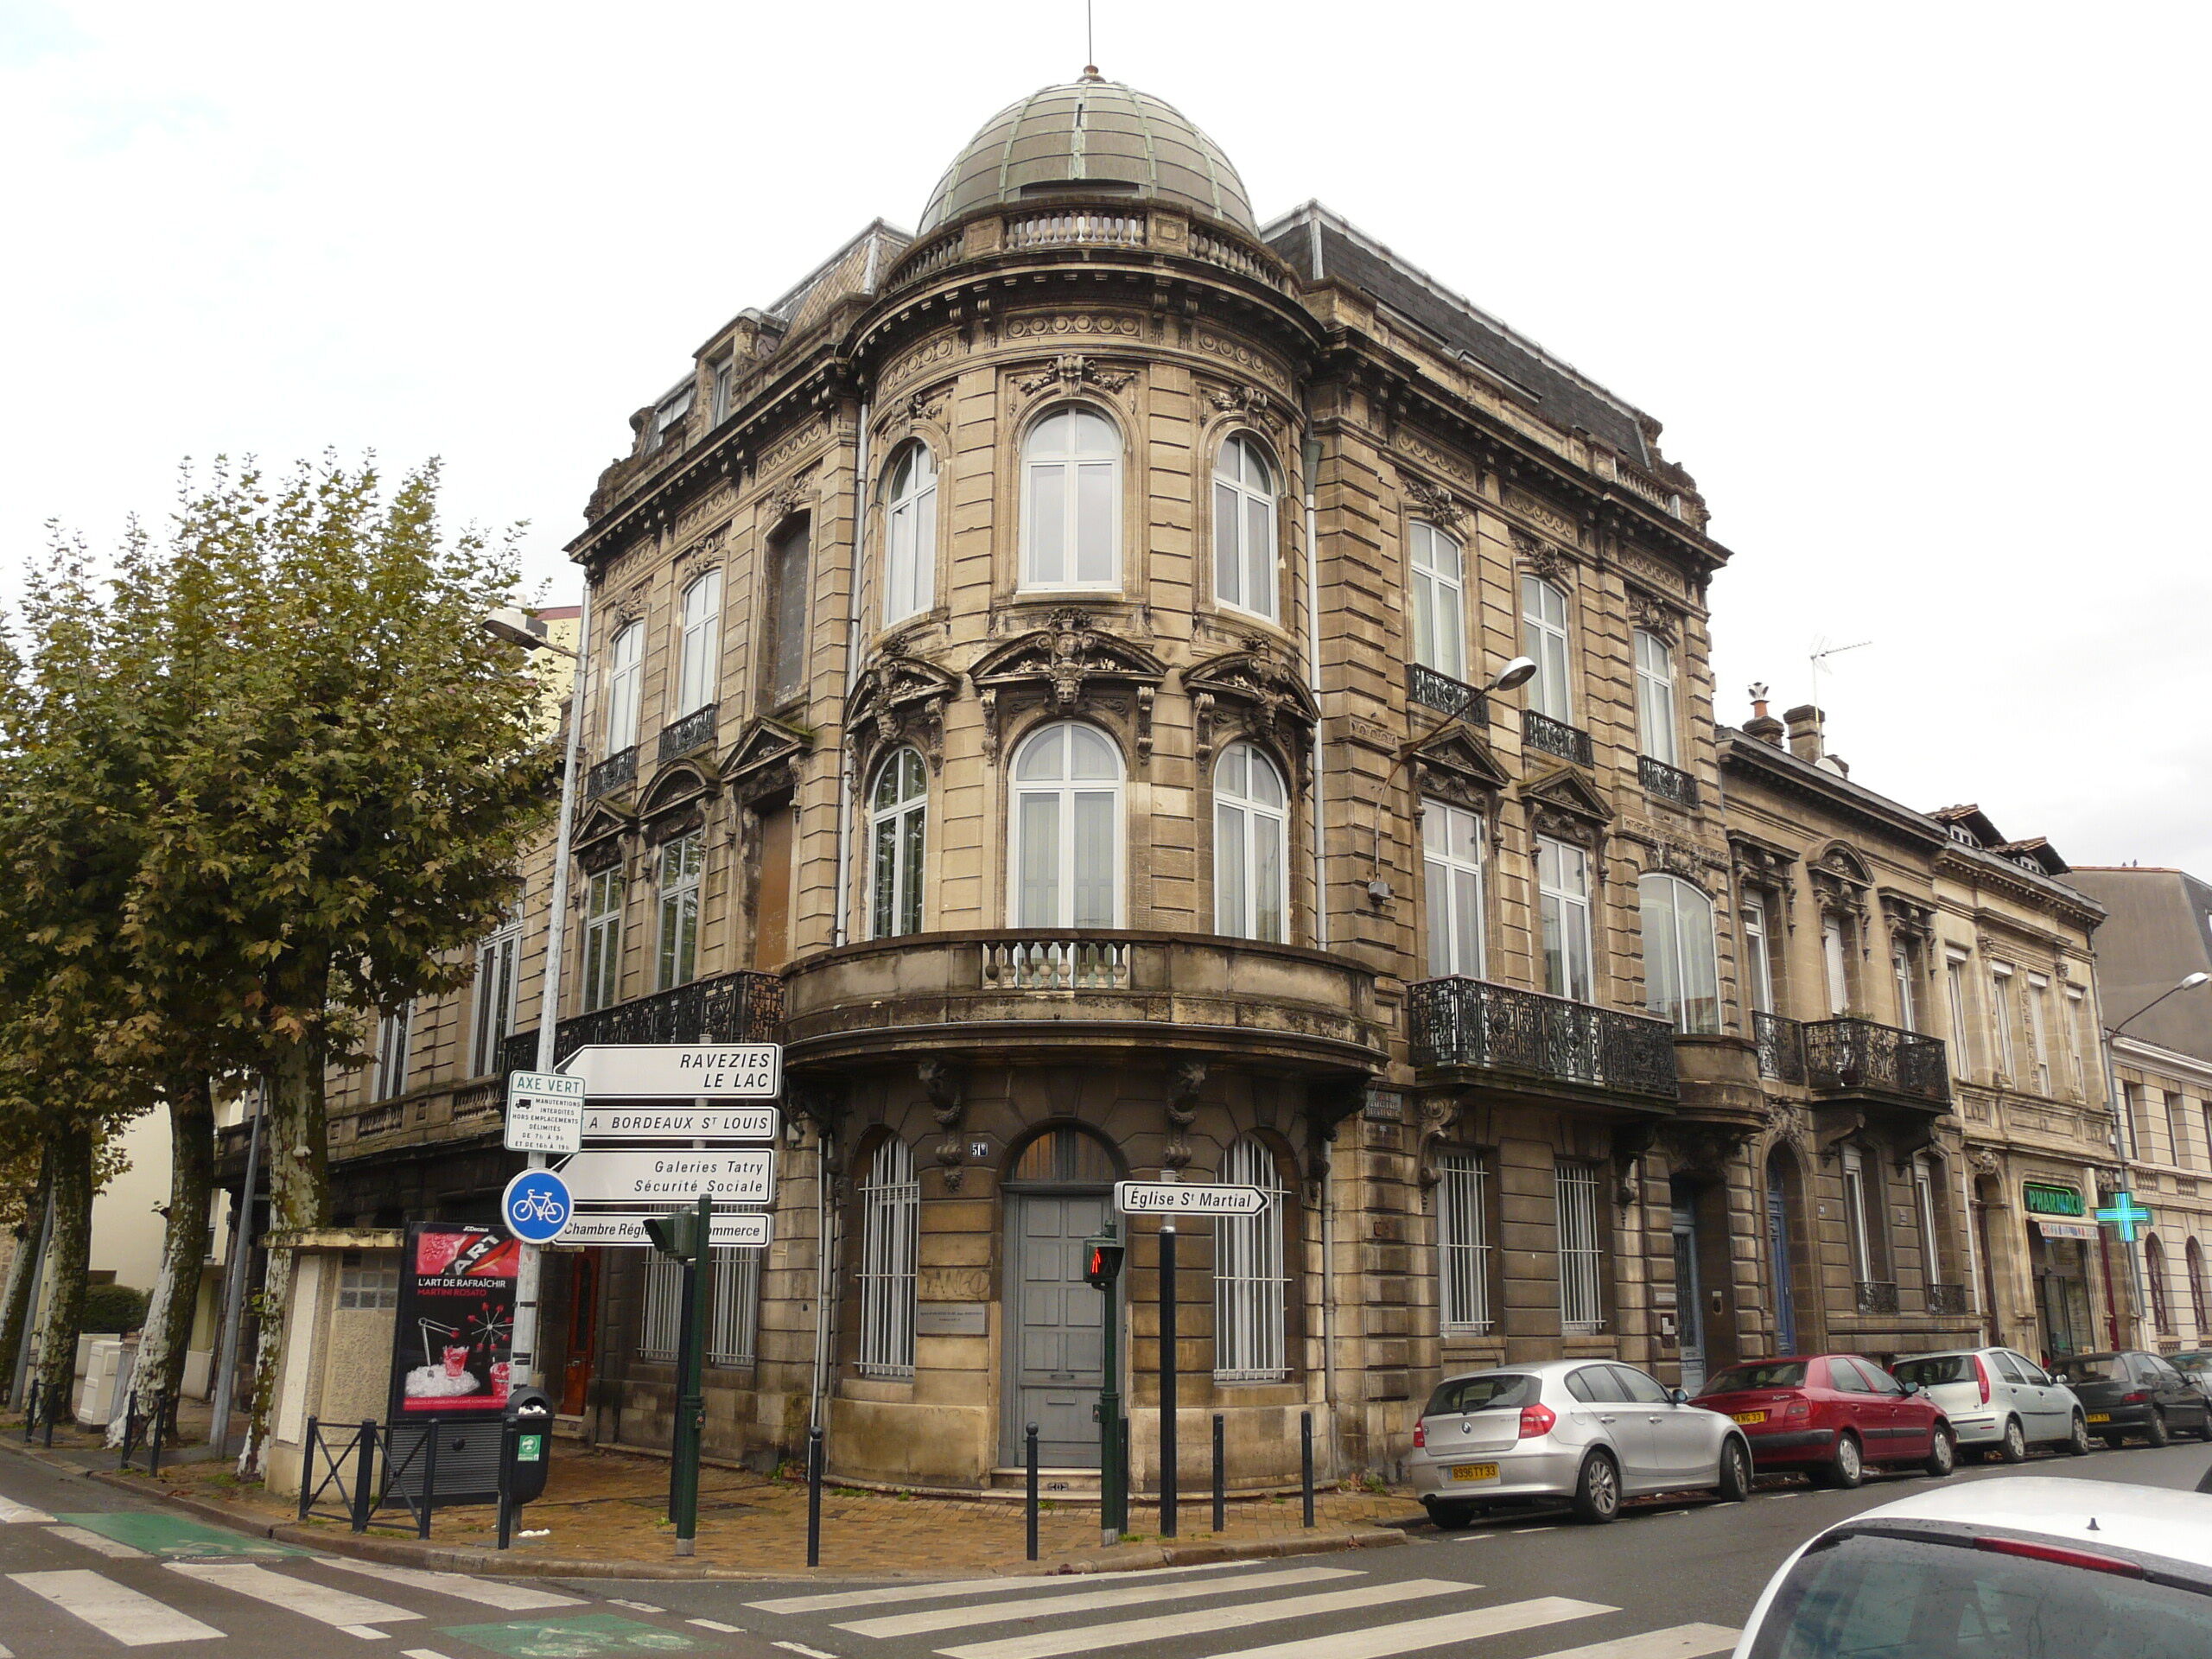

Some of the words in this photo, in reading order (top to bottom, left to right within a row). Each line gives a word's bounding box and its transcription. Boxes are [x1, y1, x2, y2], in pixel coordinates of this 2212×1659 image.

[680, 1053, 770, 1068] RAVEZIES
[518, 1077, 542, 1090] AXE
[548, 1079, 580, 1094] VERT
[703, 1073, 724, 1088] LE
[734, 1073, 768, 1088] LAC
[536, 1098, 581, 1107] MANUTENTIONS
[531, 1115, 579, 1124] EMPLACEMENTS
[612, 1116, 694, 1128] BORDEAUX
[723, 1116, 768, 1129] LOUIS
[655, 1160, 717, 1173] Galeries
[728, 1161, 763, 1175] Tatry
[634, 1180, 698, 1192] Sécurité
[707, 1180, 763, 1192] Sociale
[1130, 1187, 1174, 1209] Église
[1181, 1192, 1195, 1205] St
[1199, 1192, 1251, 1208] Martial
[2029, 1190, 2086, 1215] PHARMACIE
[564, 1223, 615, 1236] Chambre
[619, 1223, 649, 1237] Régi
[709, 1225, 760, 1236] ommerce
[418, 1278, 442, 1287] L'ART
[443, 1279, 455, 1287] DE
[1752, 1413, 1761, 1421] 33
[1474, 1467, 1484, 1478] TY
[1485, 1465, 1496, 1477] 33
